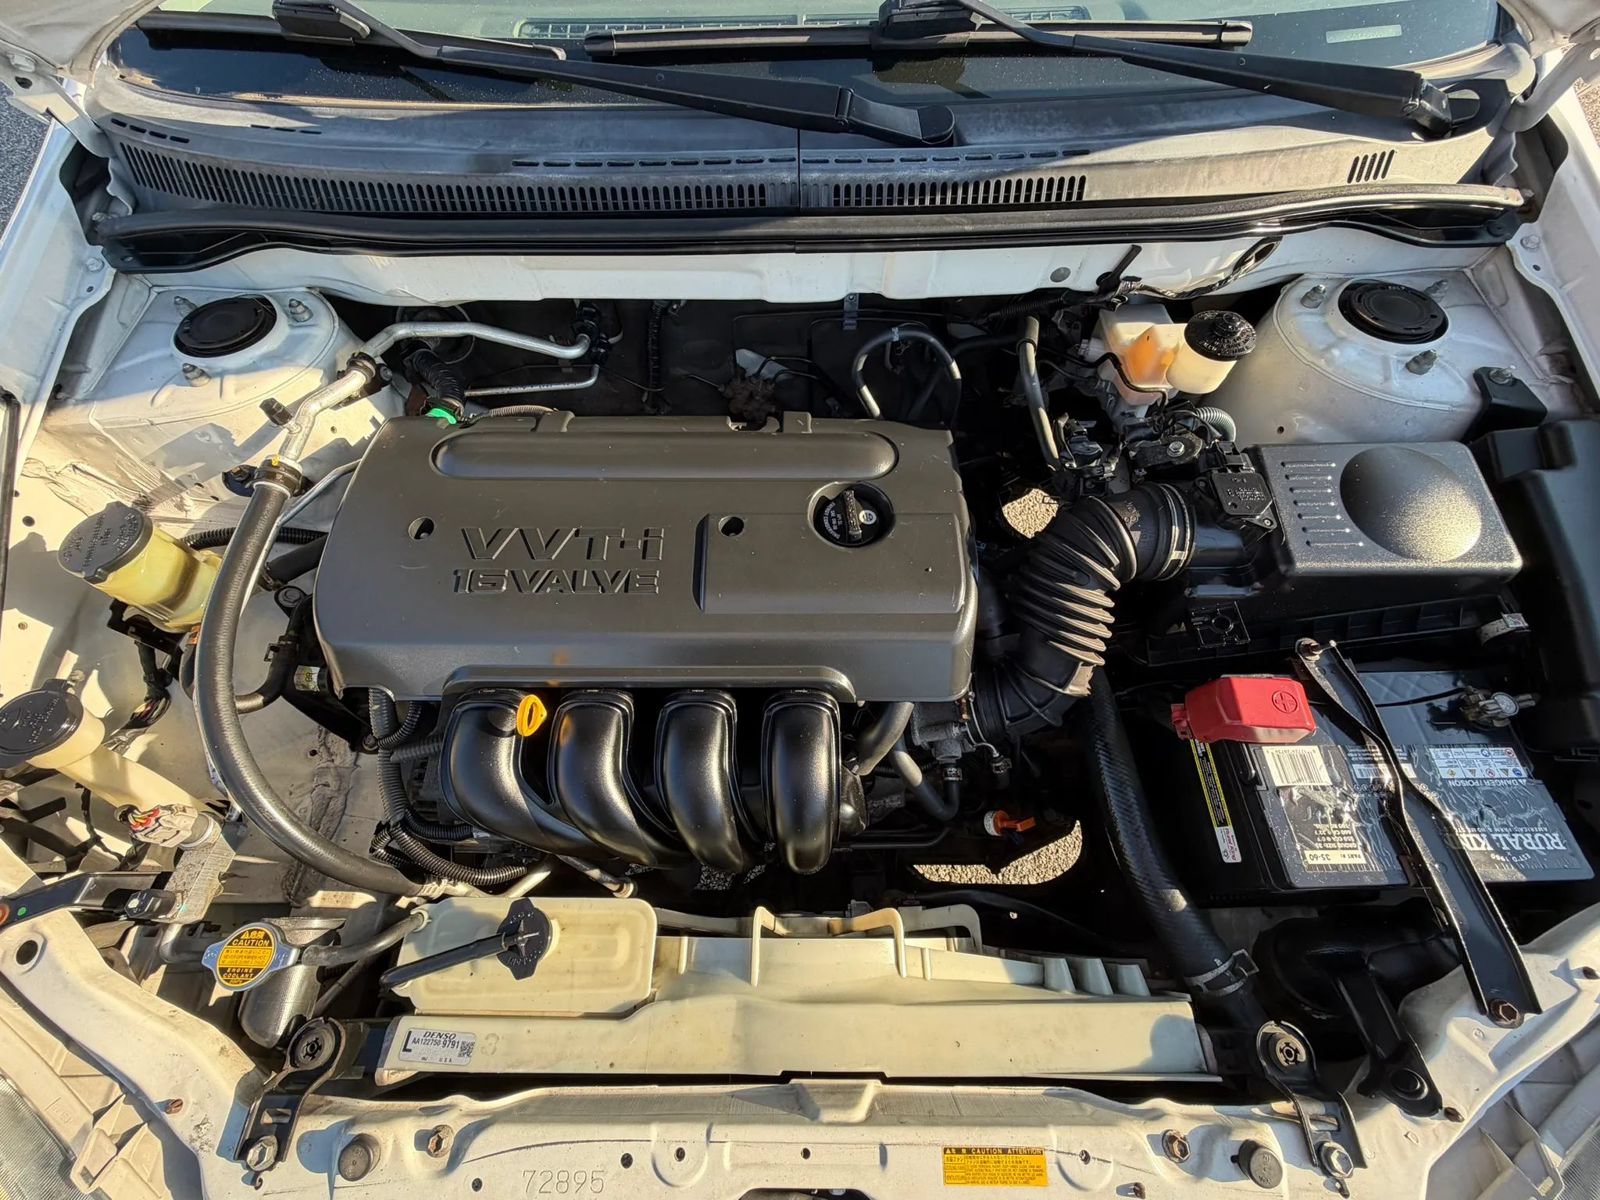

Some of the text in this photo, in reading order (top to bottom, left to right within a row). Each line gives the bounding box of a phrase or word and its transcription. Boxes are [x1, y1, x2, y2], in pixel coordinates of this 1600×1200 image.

[1447, 779, 1479, 787] POISON
[1483, 779, 1518, 787] DANGER
[1491, 833, 1567, 851] RURAL
[1309, 853, 1332, 862] 35-60
[231, 938, 270, 947] CAUTION
[423, 1031, 457, 1040] DENSO
[402, 1030, 412, 1052] L
[441, 1039, 460, 1049] 9791
[971, 1147, 1003, 1155] CAUTION
[1007, 1147, 1044, 1155] ATTENTION
[522, 1169, 605, 1194] 72895
